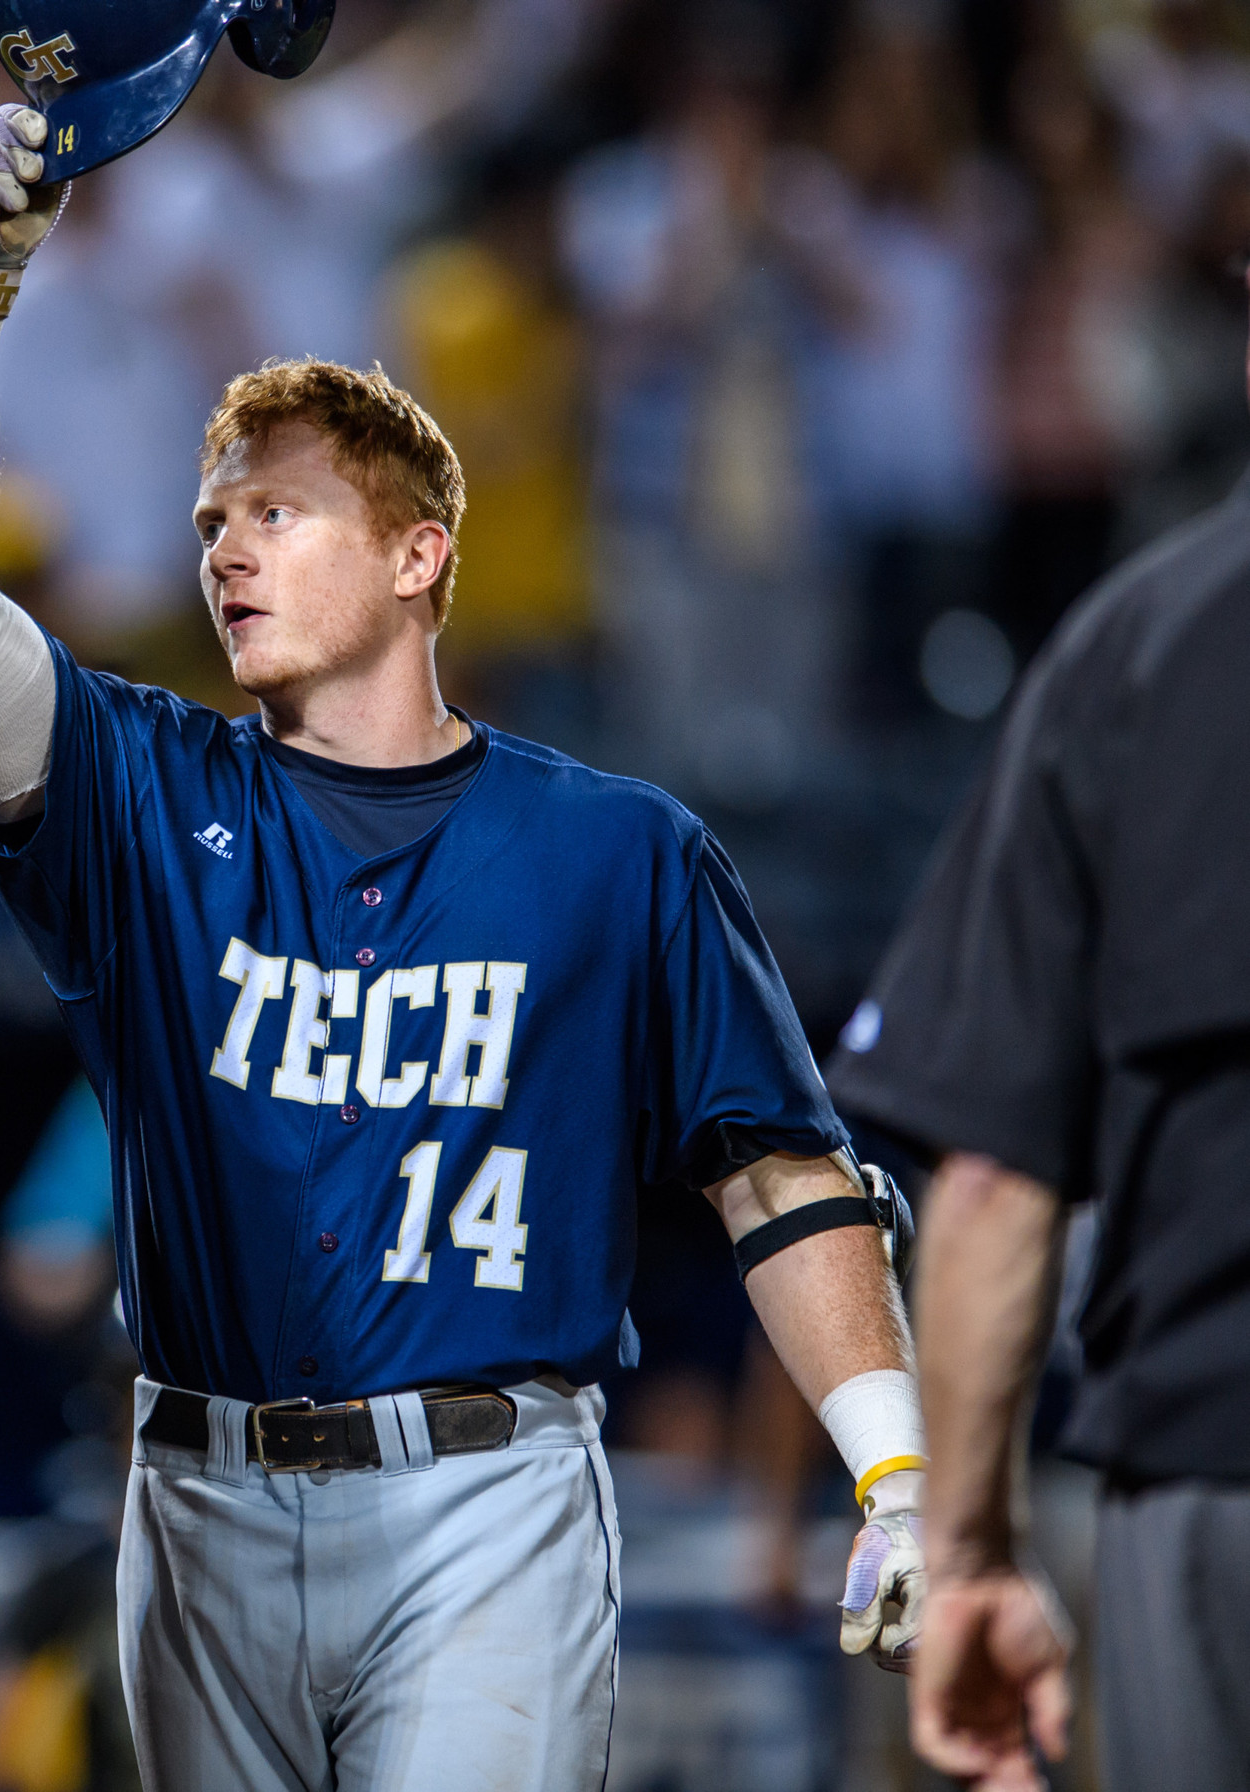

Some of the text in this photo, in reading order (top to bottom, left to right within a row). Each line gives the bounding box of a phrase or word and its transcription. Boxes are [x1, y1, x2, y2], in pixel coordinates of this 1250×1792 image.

[56, 126, 74, 155] 14
[193, 831, 234, 859] RUSSELL
[209, 937, 528, 1110] TECH
[382, 1141, 528, 1292] 14
